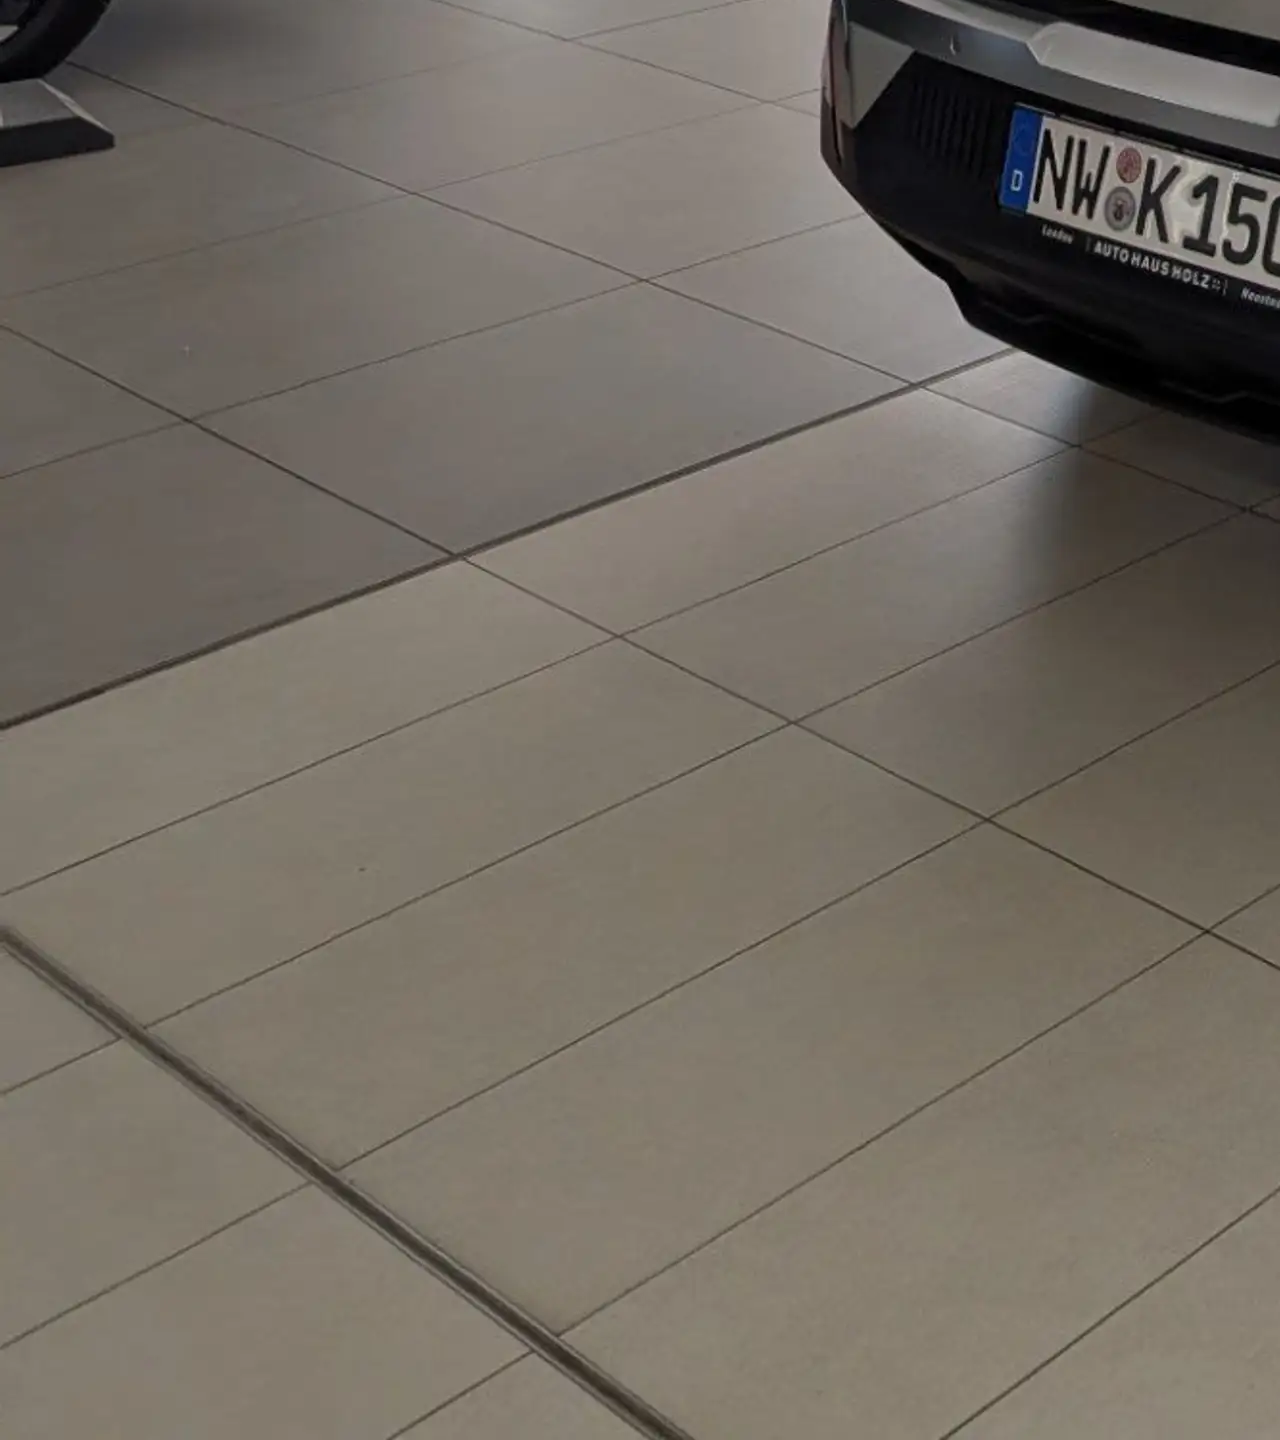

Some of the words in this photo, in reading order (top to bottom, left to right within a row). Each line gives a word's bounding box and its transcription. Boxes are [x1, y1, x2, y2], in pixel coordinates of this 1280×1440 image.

[1010, 169, 1025, 192] D
[1033, 128, 1111, 221] NW
[1171, 264, 1211, 289] HOLZ
